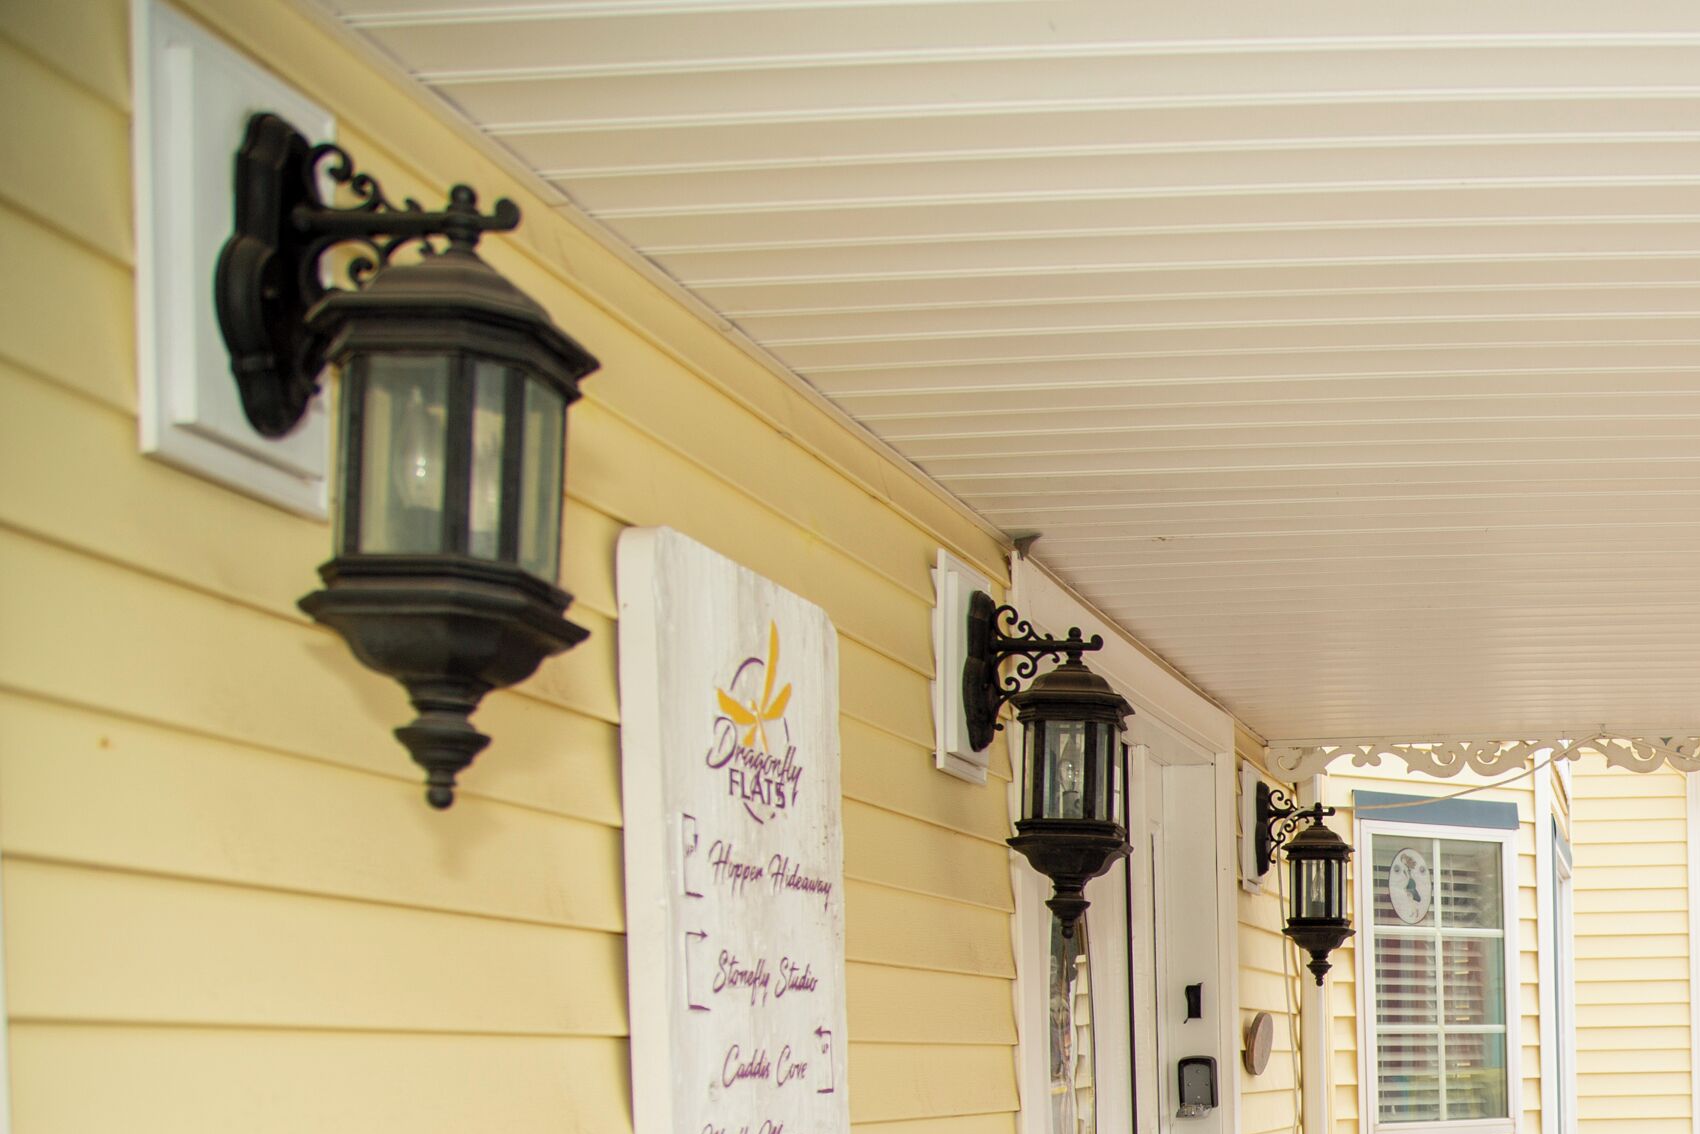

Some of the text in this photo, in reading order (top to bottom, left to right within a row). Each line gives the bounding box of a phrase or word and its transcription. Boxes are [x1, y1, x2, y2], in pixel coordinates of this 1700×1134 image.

[706, 716, 803, 807] Dragonfly
[728, 767, 786, 809] FLATS
[708, 840, 832, 912] Hopper Hideaway
[712, 949, 819, 1007] Stonefly Studio
[722, 1044, 808, 1088] Caddis Cove
